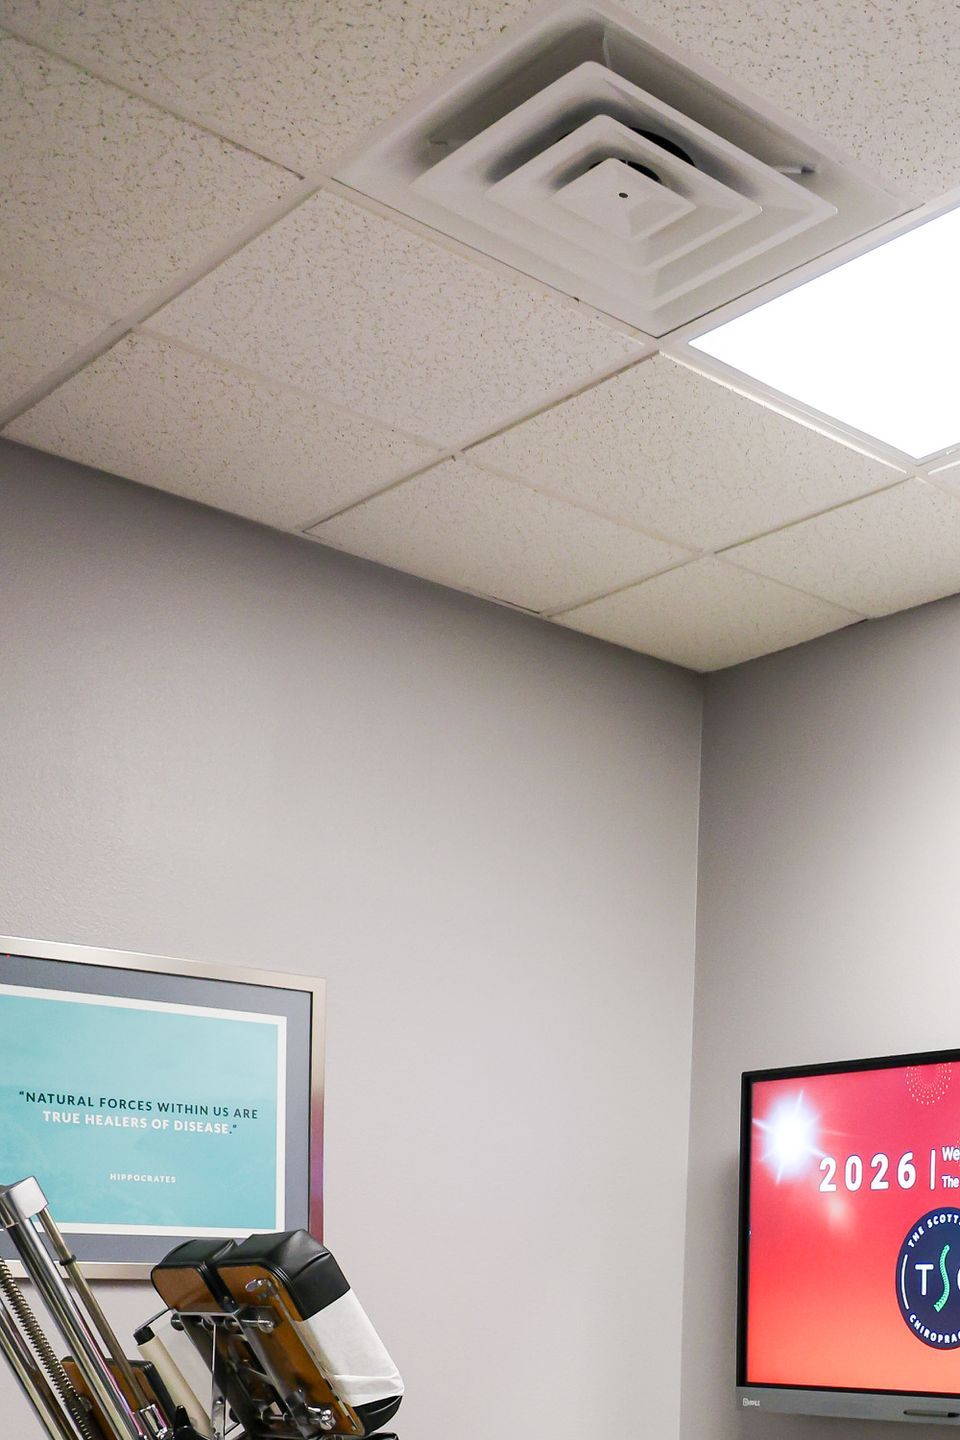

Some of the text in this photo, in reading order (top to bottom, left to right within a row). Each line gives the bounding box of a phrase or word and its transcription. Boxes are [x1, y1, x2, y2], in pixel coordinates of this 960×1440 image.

[99, 1097, 152, 1111] FORCES
[157, 1102, 208, 1116] WITHIN
[213, 1106, 229, 1118] US
[233, 1108, 258, 1120] ARE
[43, 1110, 81, 1125] TRUE
[85, 1114, 147, 1129] HEALERS
[151, 1118, 170, 1130] OF
[110, 1173, 176, 1184] HIPPOCRATES
[818, 1152, 917, 1193] 2026
[941, 1175, 959, 1188] The
[907, 1226, 926, 1249] THE
